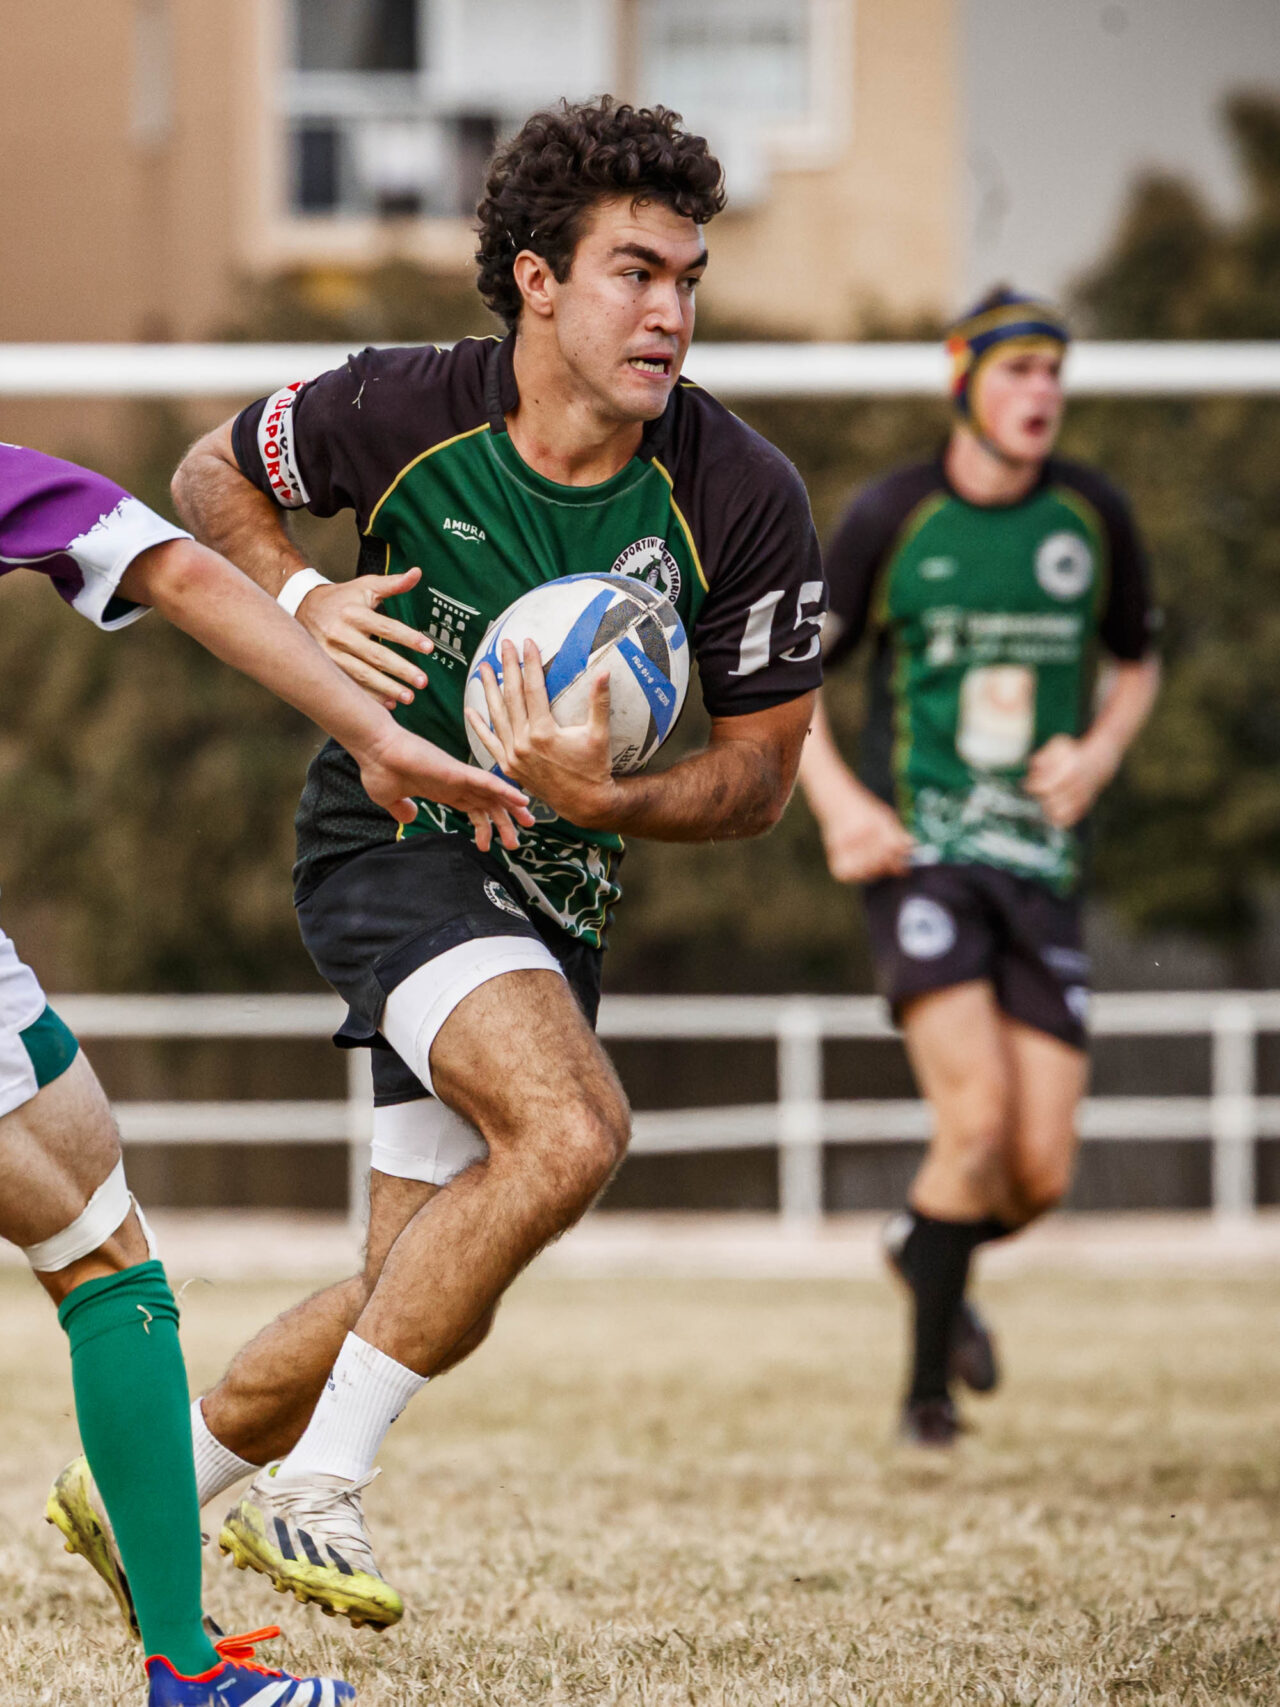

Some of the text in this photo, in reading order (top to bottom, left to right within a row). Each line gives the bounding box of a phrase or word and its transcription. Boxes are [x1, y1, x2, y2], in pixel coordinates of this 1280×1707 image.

[443, 517, 487, 541] AMURA
[614, 538, 658, 572] DEPORTIV
[728, 581, 827, 676] 15
[431, 652, 455, 670] 542
